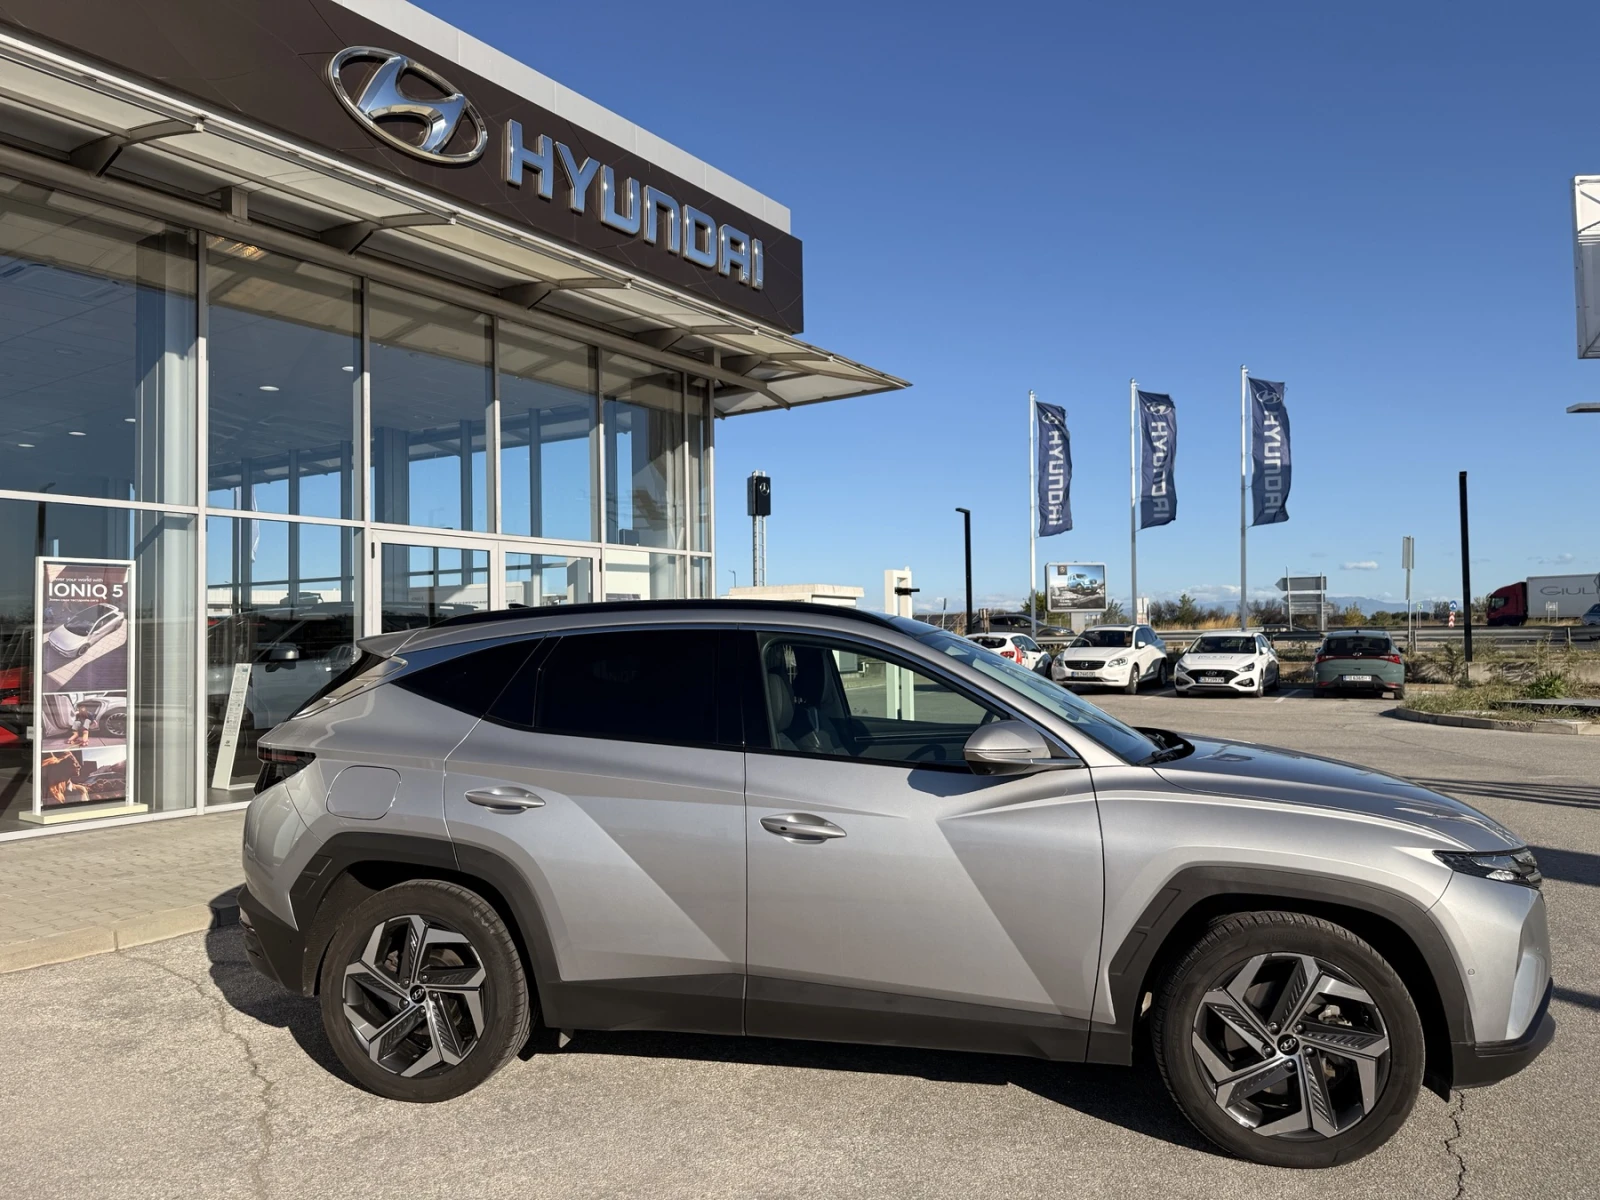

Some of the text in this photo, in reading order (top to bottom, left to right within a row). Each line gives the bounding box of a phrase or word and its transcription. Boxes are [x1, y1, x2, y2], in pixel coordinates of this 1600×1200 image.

[506, 118, 764, 290] HYUNDAI
[1048, 430, 1063, 525] HYUNDAI
[1151, 421, 1169, 518] HYUNDAI
[1264, 411, 1282, 513] HYUNDAI
[48, 582, 124, 600] IONIQ 5
